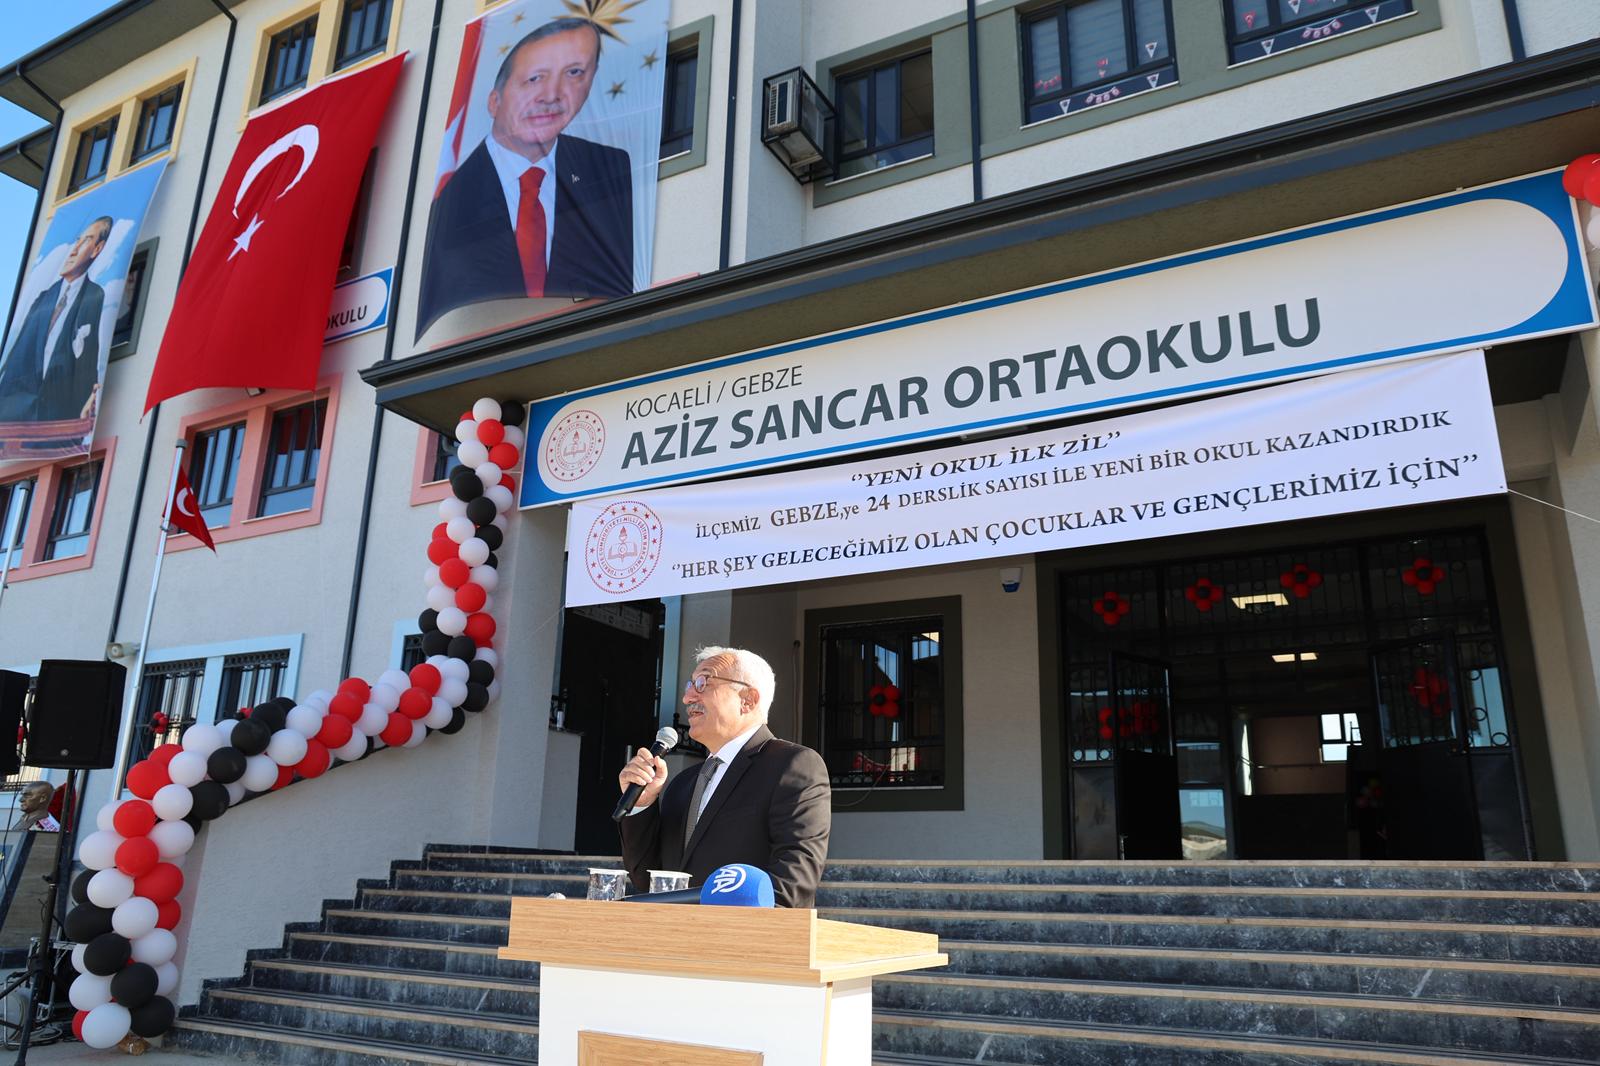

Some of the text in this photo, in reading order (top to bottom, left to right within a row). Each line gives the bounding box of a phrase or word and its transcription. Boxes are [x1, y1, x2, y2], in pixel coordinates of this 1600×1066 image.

[620, 412, 720, 470] AZİZ
[729, 376, 929, 449] SANCAR
[943, 297, 1321, 408] ORTAOKULU
[625, 380, 711, 421] KOCAELİ
[731, 365, 803, 398] GEBZE
[695, 515, 761, 540] İLÇEMİZ
[866, 494, 891, 513] 24
[898, 481, 982, 508] DERSLİK
[985, 471, 1048, 495] SAYISI
[1053, 466, 1087, 485] İLE
[1090, 453, 1145, 479] YENİ
[1148, 449, 1190, 471] BİR
[1193, 440, 1261, 464] OKUL
[1265, 410, 1452, 454] KAZANDIRDIK
[930, 453, 1003, 478] OKUL
[1008, 446, 1056, 465] İLK
[723, 555, 758, 579] ŞEY
[761, 533, 909, 569] GELECEĞİMİZ
[914, 525, 979, 550] OLAN
[985, 506, 1127, 545] ÇOCUKLAR
[1130, 500, 1167, 521] VE
[1173, 467, 1381, 515] GENÇLERİMİZ
